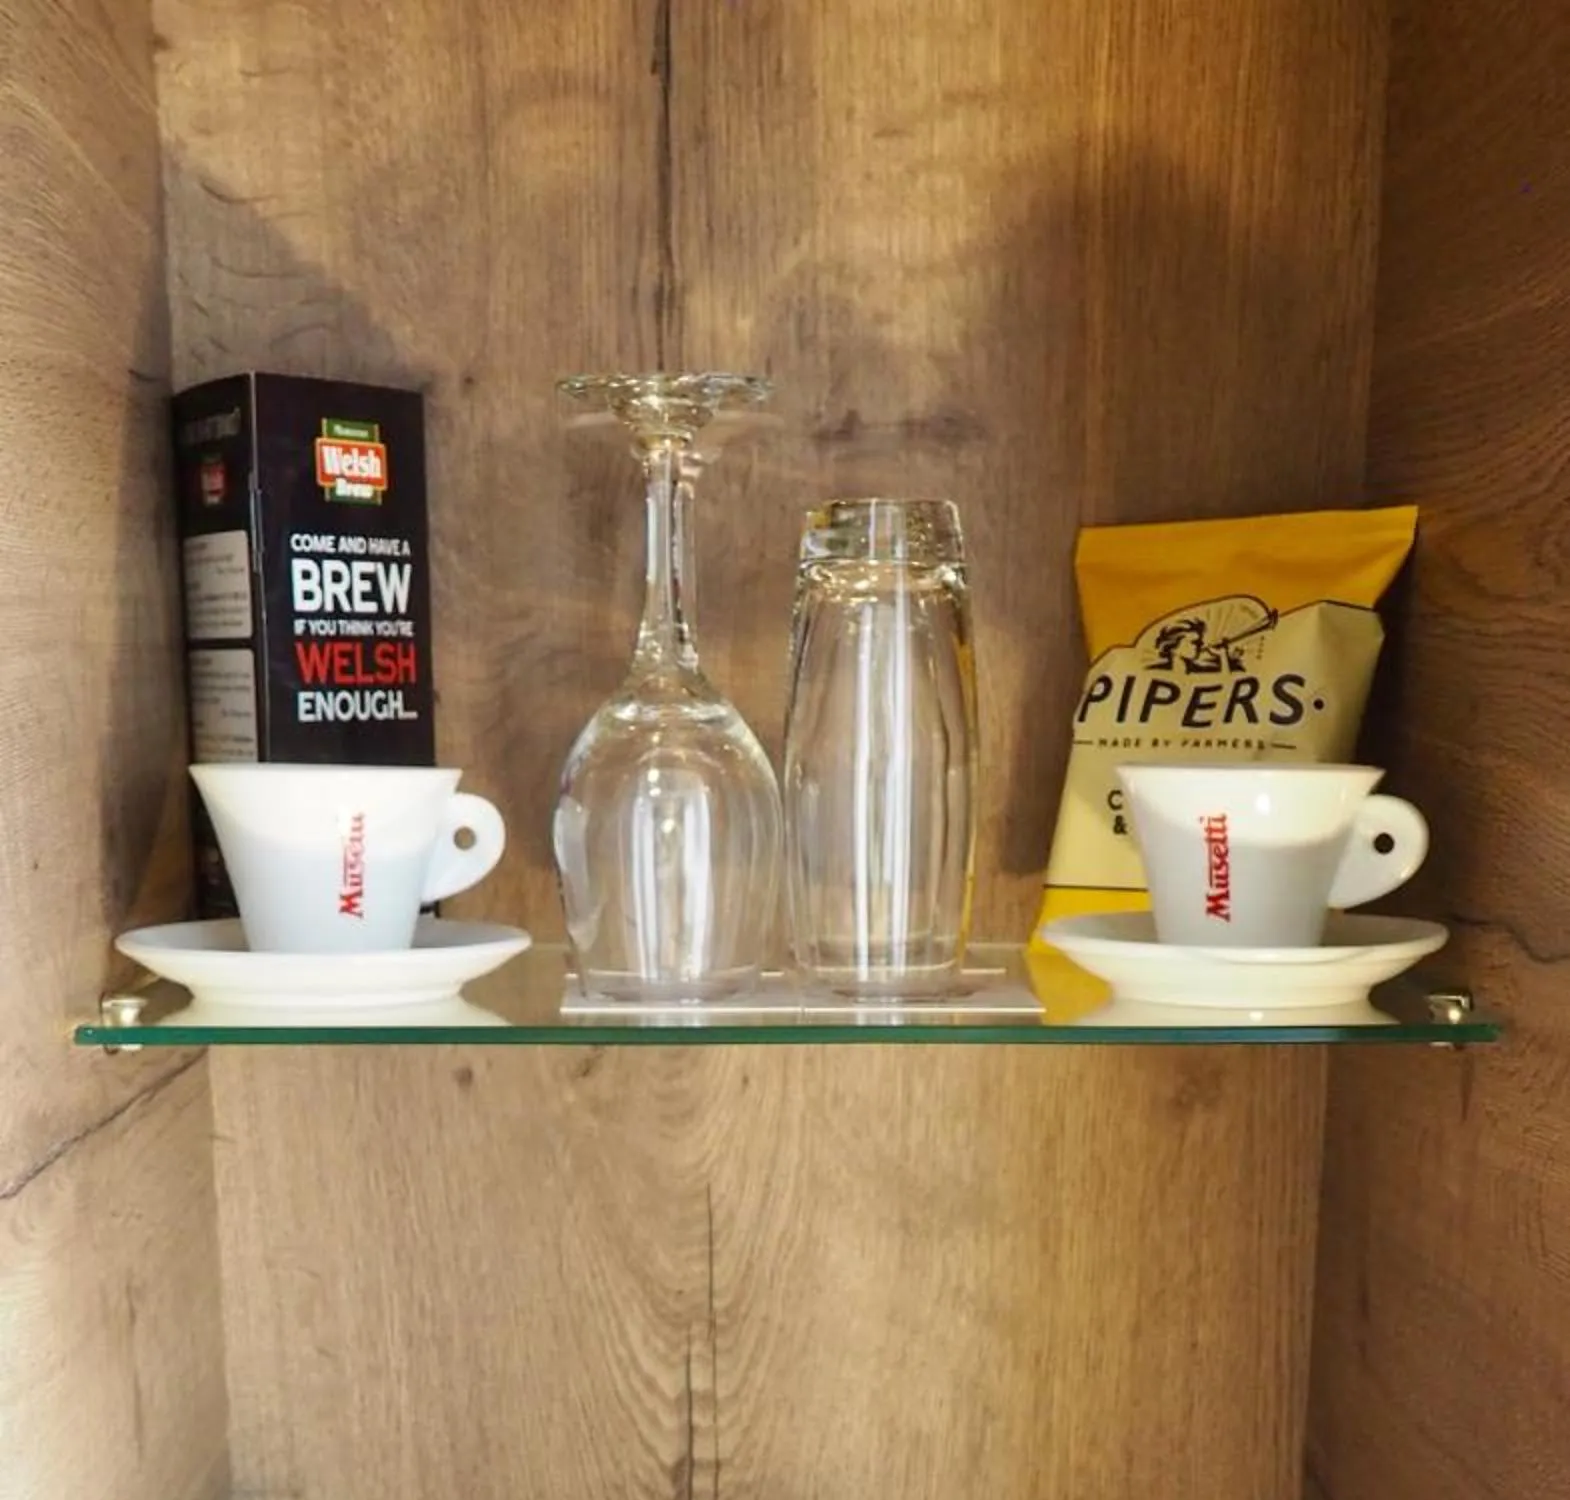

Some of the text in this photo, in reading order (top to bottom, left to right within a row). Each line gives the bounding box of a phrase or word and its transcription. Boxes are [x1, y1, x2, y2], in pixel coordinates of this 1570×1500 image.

[322, 446, 382, 478] Welsh
[290, 533, 412, 556] COME AND HAVE A
[291, 558, 412, 614] BREW
[294, 619, 306, 636] IF
[308, 620, 338, 637] YOU
[338, 620, 375, 637] THINK
[295, 640, 416, 685] WELSH
[1077, 673, 1306, 728] PIPERS
[1098, 737, 1266, 751] MADE BY FARMERS
[1205, 813, 1231, 923] Musetti
